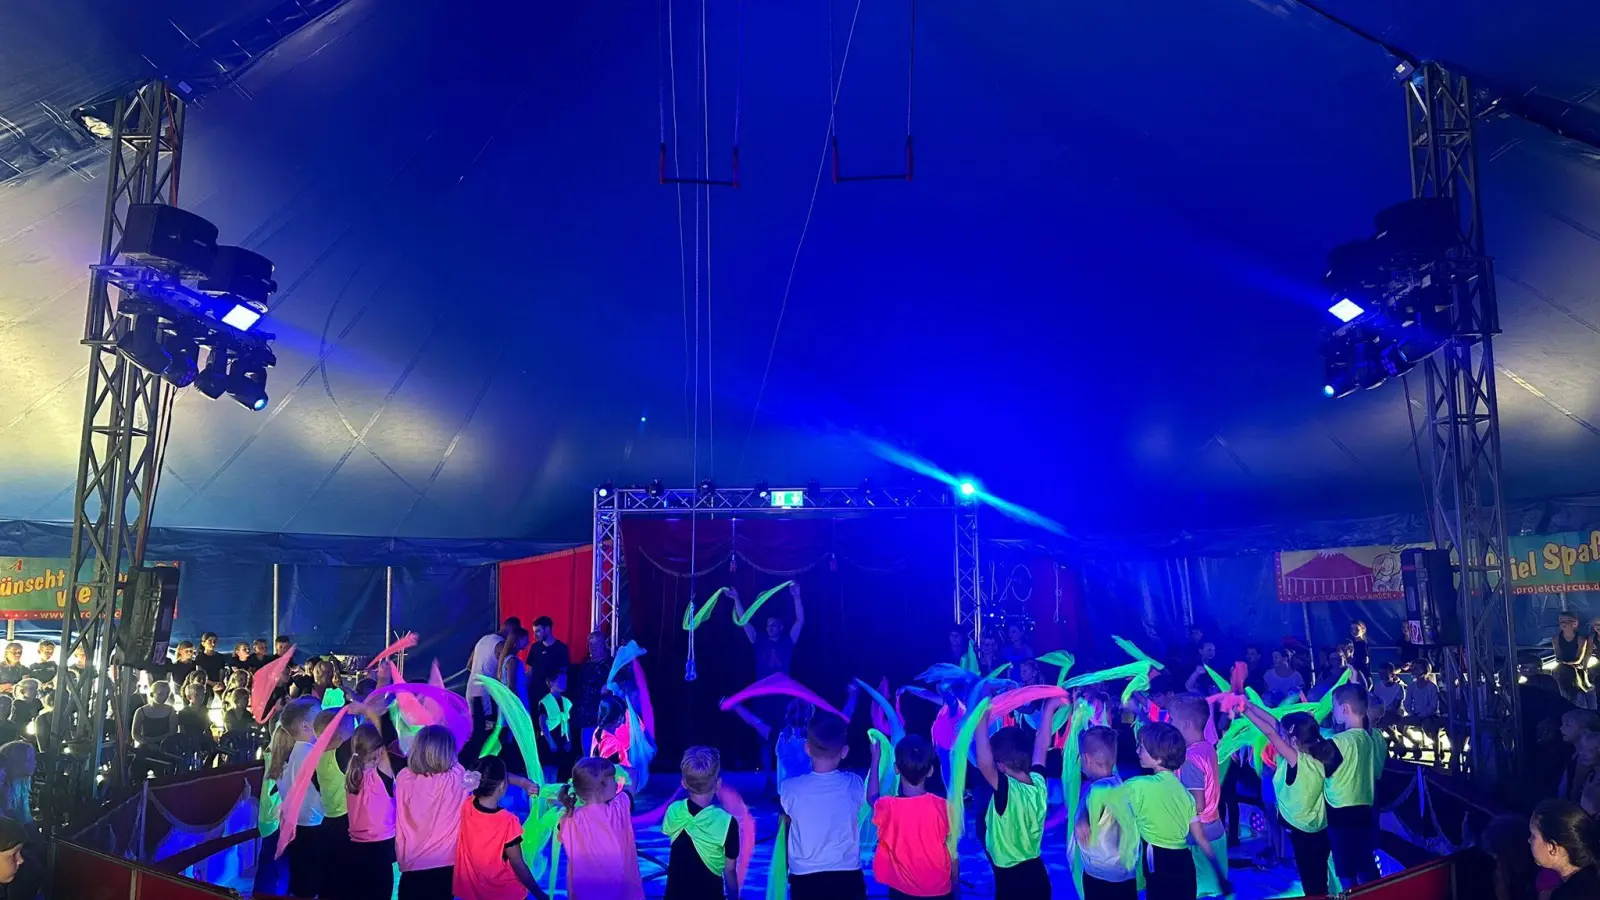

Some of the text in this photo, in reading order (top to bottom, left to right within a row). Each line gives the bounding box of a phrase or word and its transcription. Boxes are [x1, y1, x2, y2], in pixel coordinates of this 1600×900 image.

[1510, 549, 1537, 581] iel
[0, 567, 65, 597] ünscht
[1513, 582, 1600, 595] .projektcircus.d
